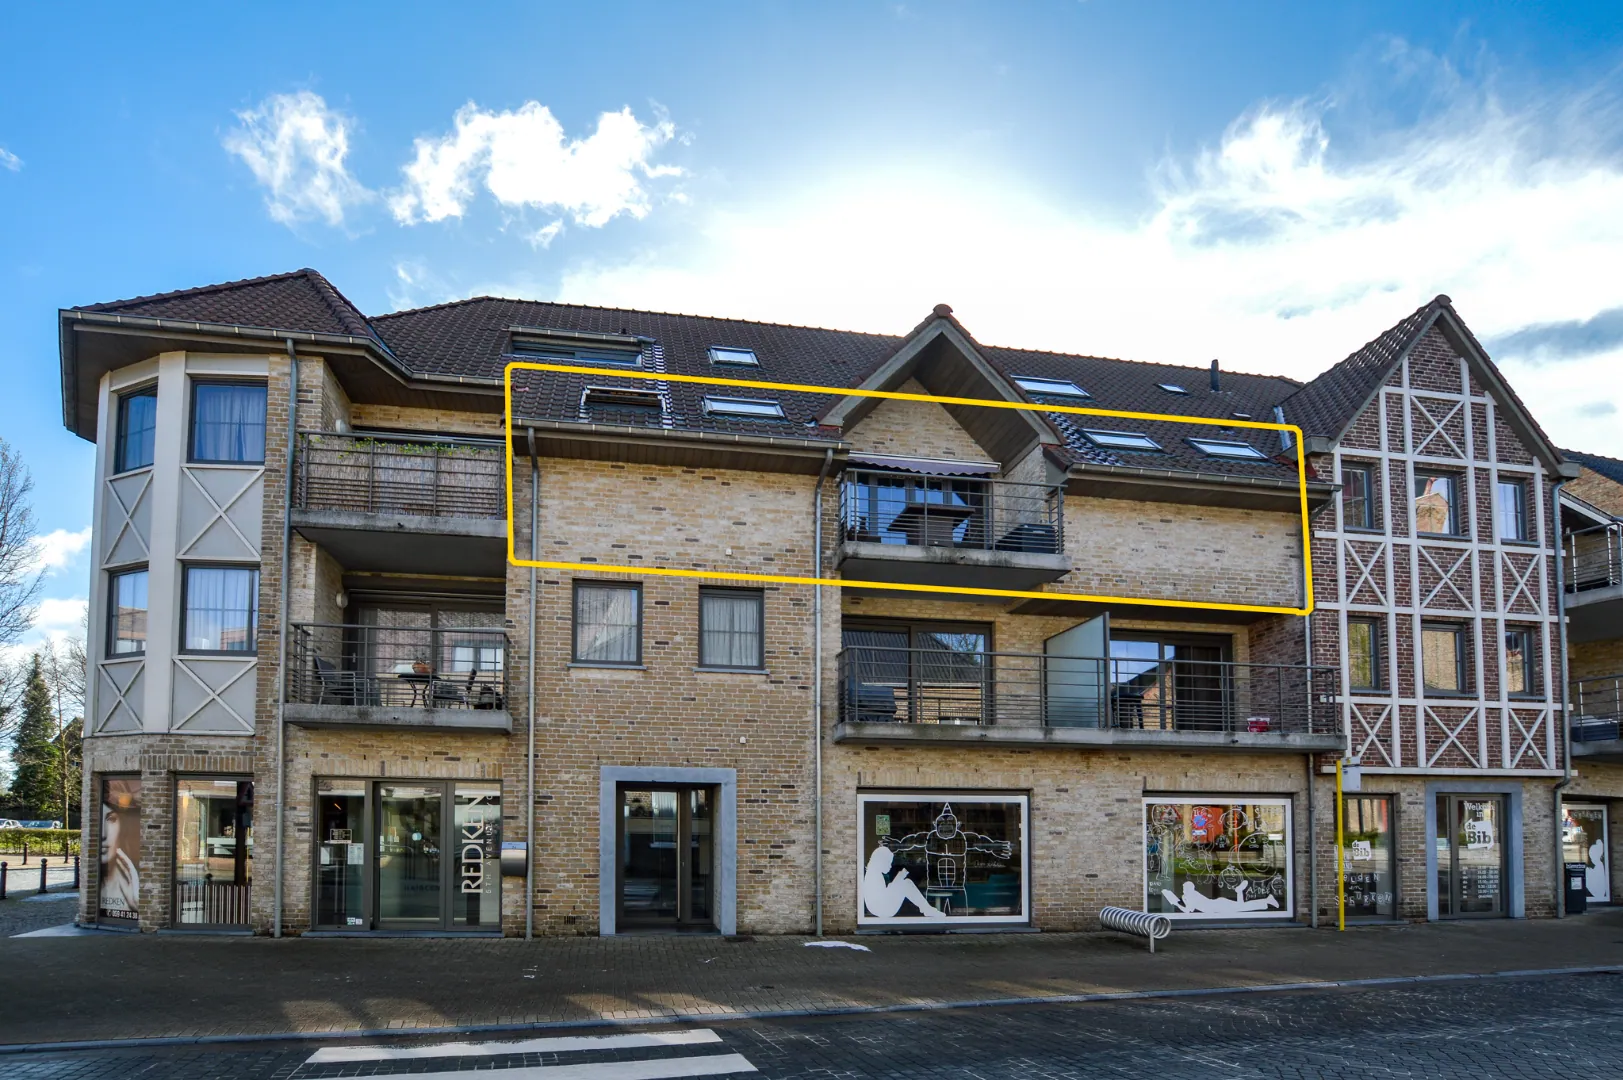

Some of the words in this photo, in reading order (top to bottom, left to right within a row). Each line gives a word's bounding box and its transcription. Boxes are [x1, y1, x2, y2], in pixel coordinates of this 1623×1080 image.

[1467, 822, 1476, 830] de
[1467, 831, 1491, 844] Bib
[461, 795, 484, 893] REDKEN
[485, 822, 493, 866] AVENUE
[1354, 848, 1369, 857] Bib
[101, 896, 125, 906] REDKEN
